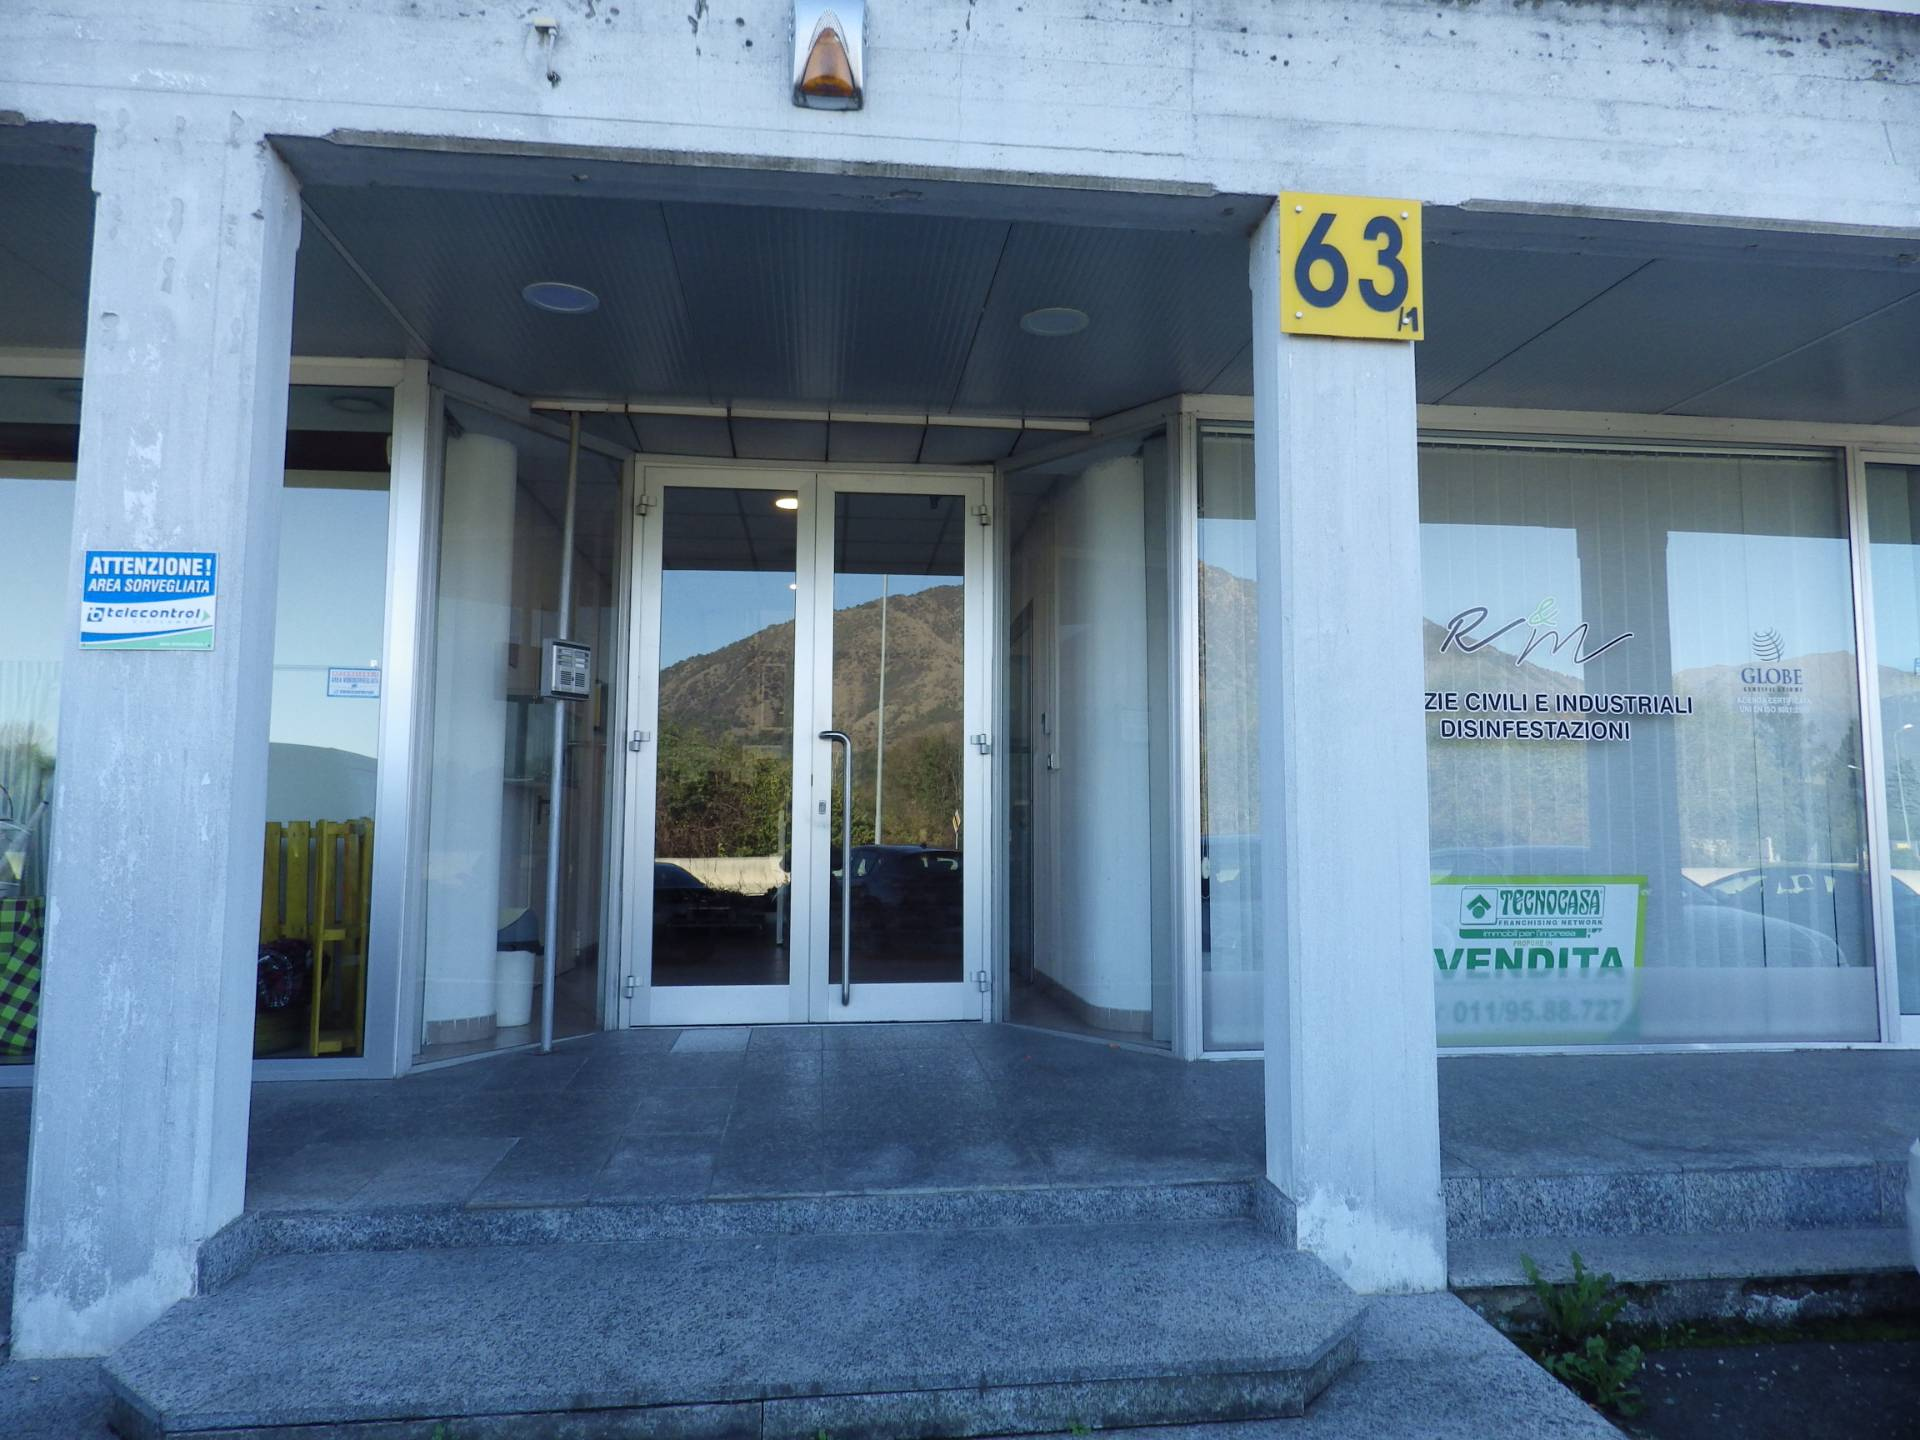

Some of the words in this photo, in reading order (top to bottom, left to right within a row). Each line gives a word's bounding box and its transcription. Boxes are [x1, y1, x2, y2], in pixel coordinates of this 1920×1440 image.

[1295, 213, 1409, 313] 63
[88, 578, 121, 592] AREA
[124, 579, 210, 593] SORVEGLIATA
[1741, 667, 1803, 685] GLOBE
[1465, 692, 1528, 712] CIVILI
[1536, 694, 1549, 712] E
[1556, 694, 1693, 714] INDUSTRIALI
[1441, 719, 1630, 739] DISINFESTAZIONI
[1500, 889, 1600, 916] TECNOCASA
[1434, 947, 1624, 977] VENDITA
